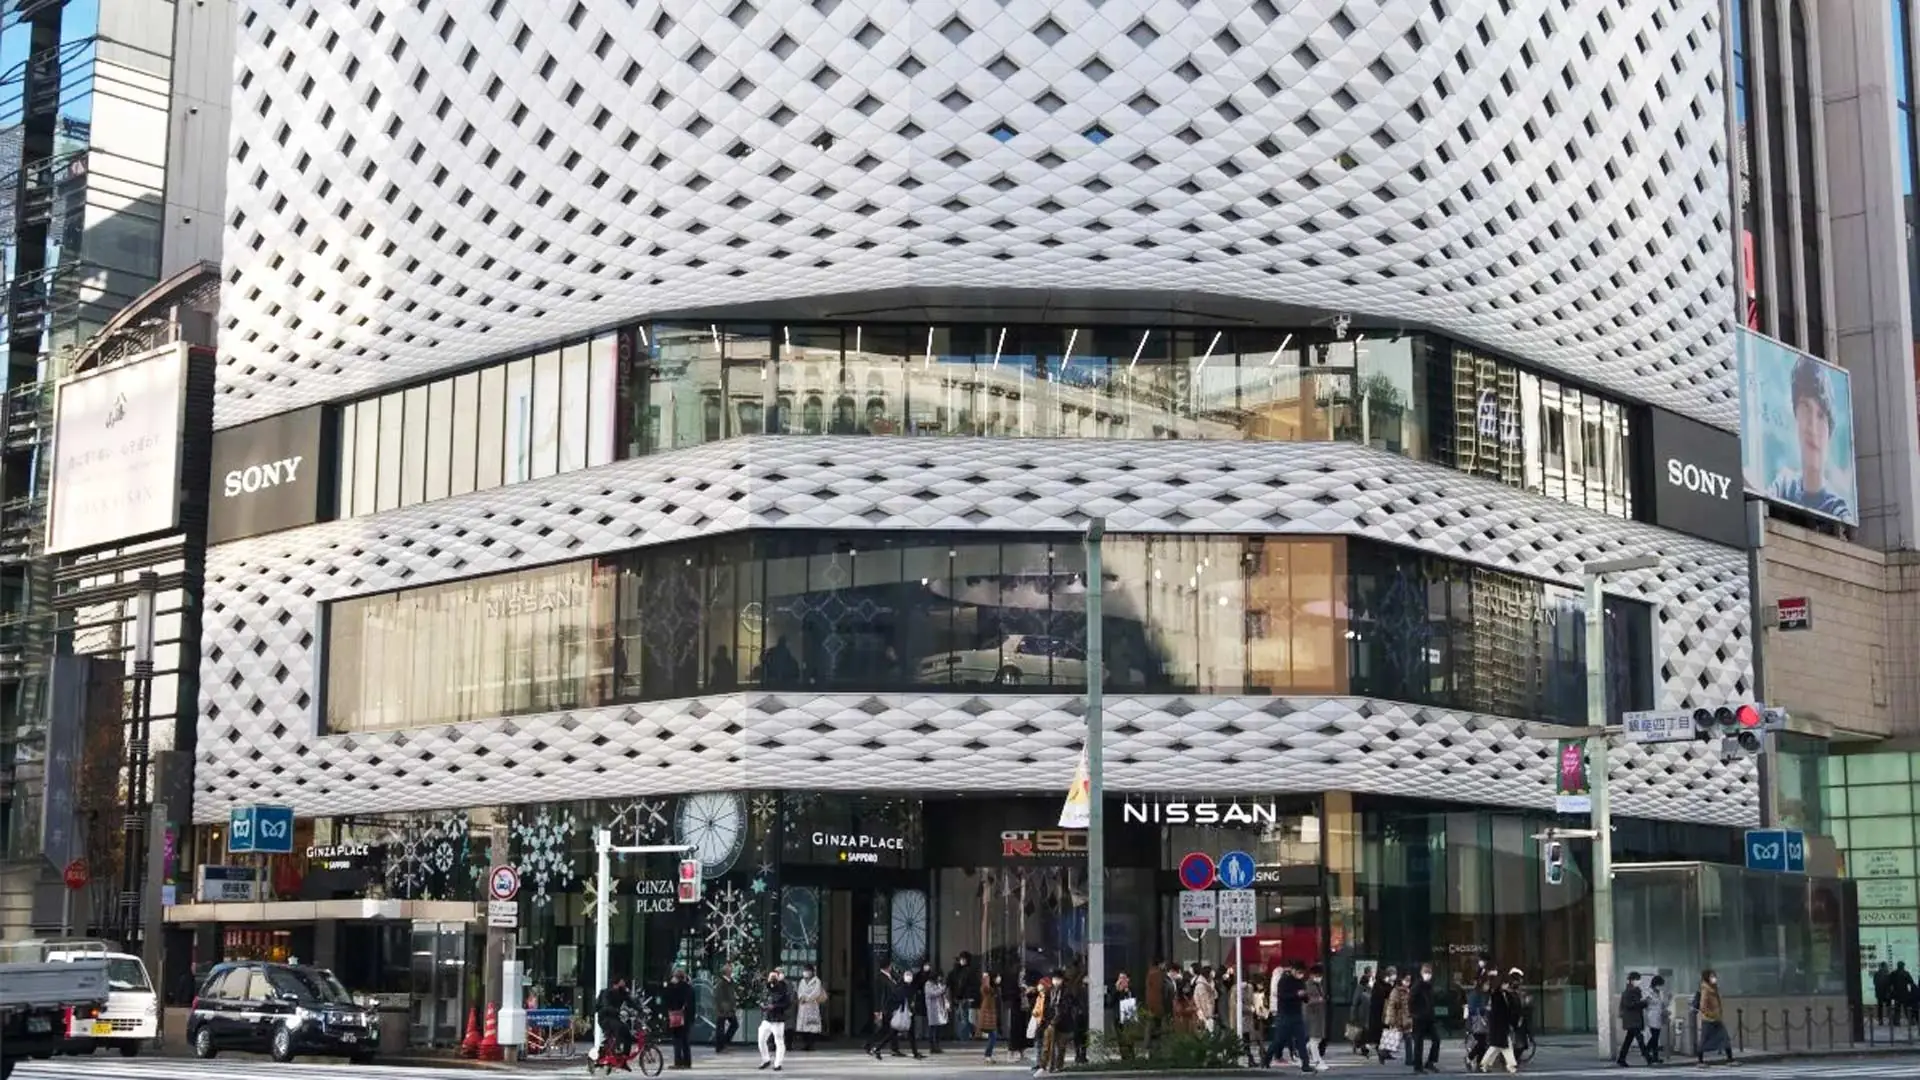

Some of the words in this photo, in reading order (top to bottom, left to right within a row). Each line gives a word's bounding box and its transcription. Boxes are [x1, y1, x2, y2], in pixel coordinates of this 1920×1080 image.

[225, 456, 302, 497] SONY
[1668, 458, 1731, 500] SONY
[487, 591, 574, 619] NISSAN
[1488, 597, 1557, 626] NISSAN
[1124, 803, 1276, 823] NISSAN
[812, 832, 857, 846] GINZA
[859, 835, 903, 849] PLACE
[306, 846, 336, 858] GINZA
[337, 845, 369, 856] PLACE
[848, 852, 878, 862] SAPPORO
[1256, 870, 1280, 881] SING
[636, 880, 675, 894] GINZA
[636, 898, 676, 913] PLACE
